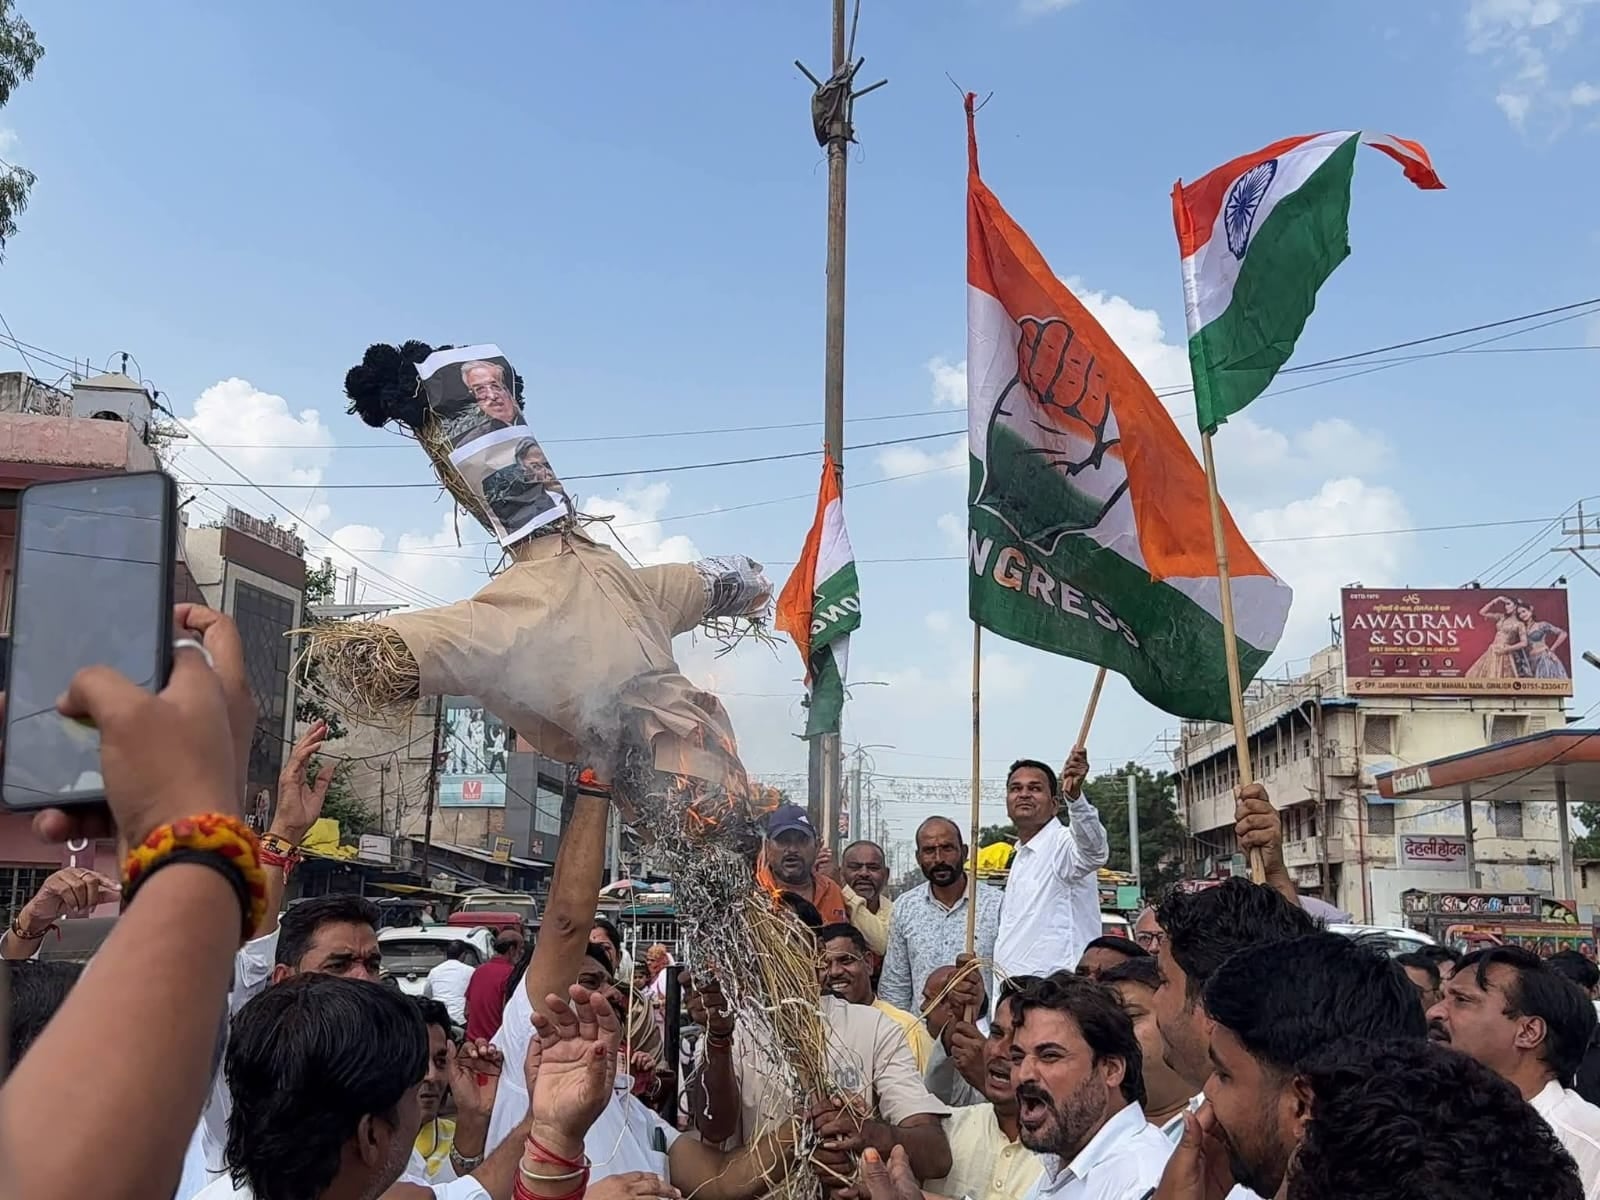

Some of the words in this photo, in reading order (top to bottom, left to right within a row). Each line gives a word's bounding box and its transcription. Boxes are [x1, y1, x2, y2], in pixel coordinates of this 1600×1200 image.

[1351, 613, 1475, 630] AWATRAM
[1370, 630, 1387, 645] &
[1393, 630, 1457, 646] SONS
[467, 781, 478, 793] V
[1404, 837, 1437, 857] देहली
[1437, 838, 1466, 857] होटल
